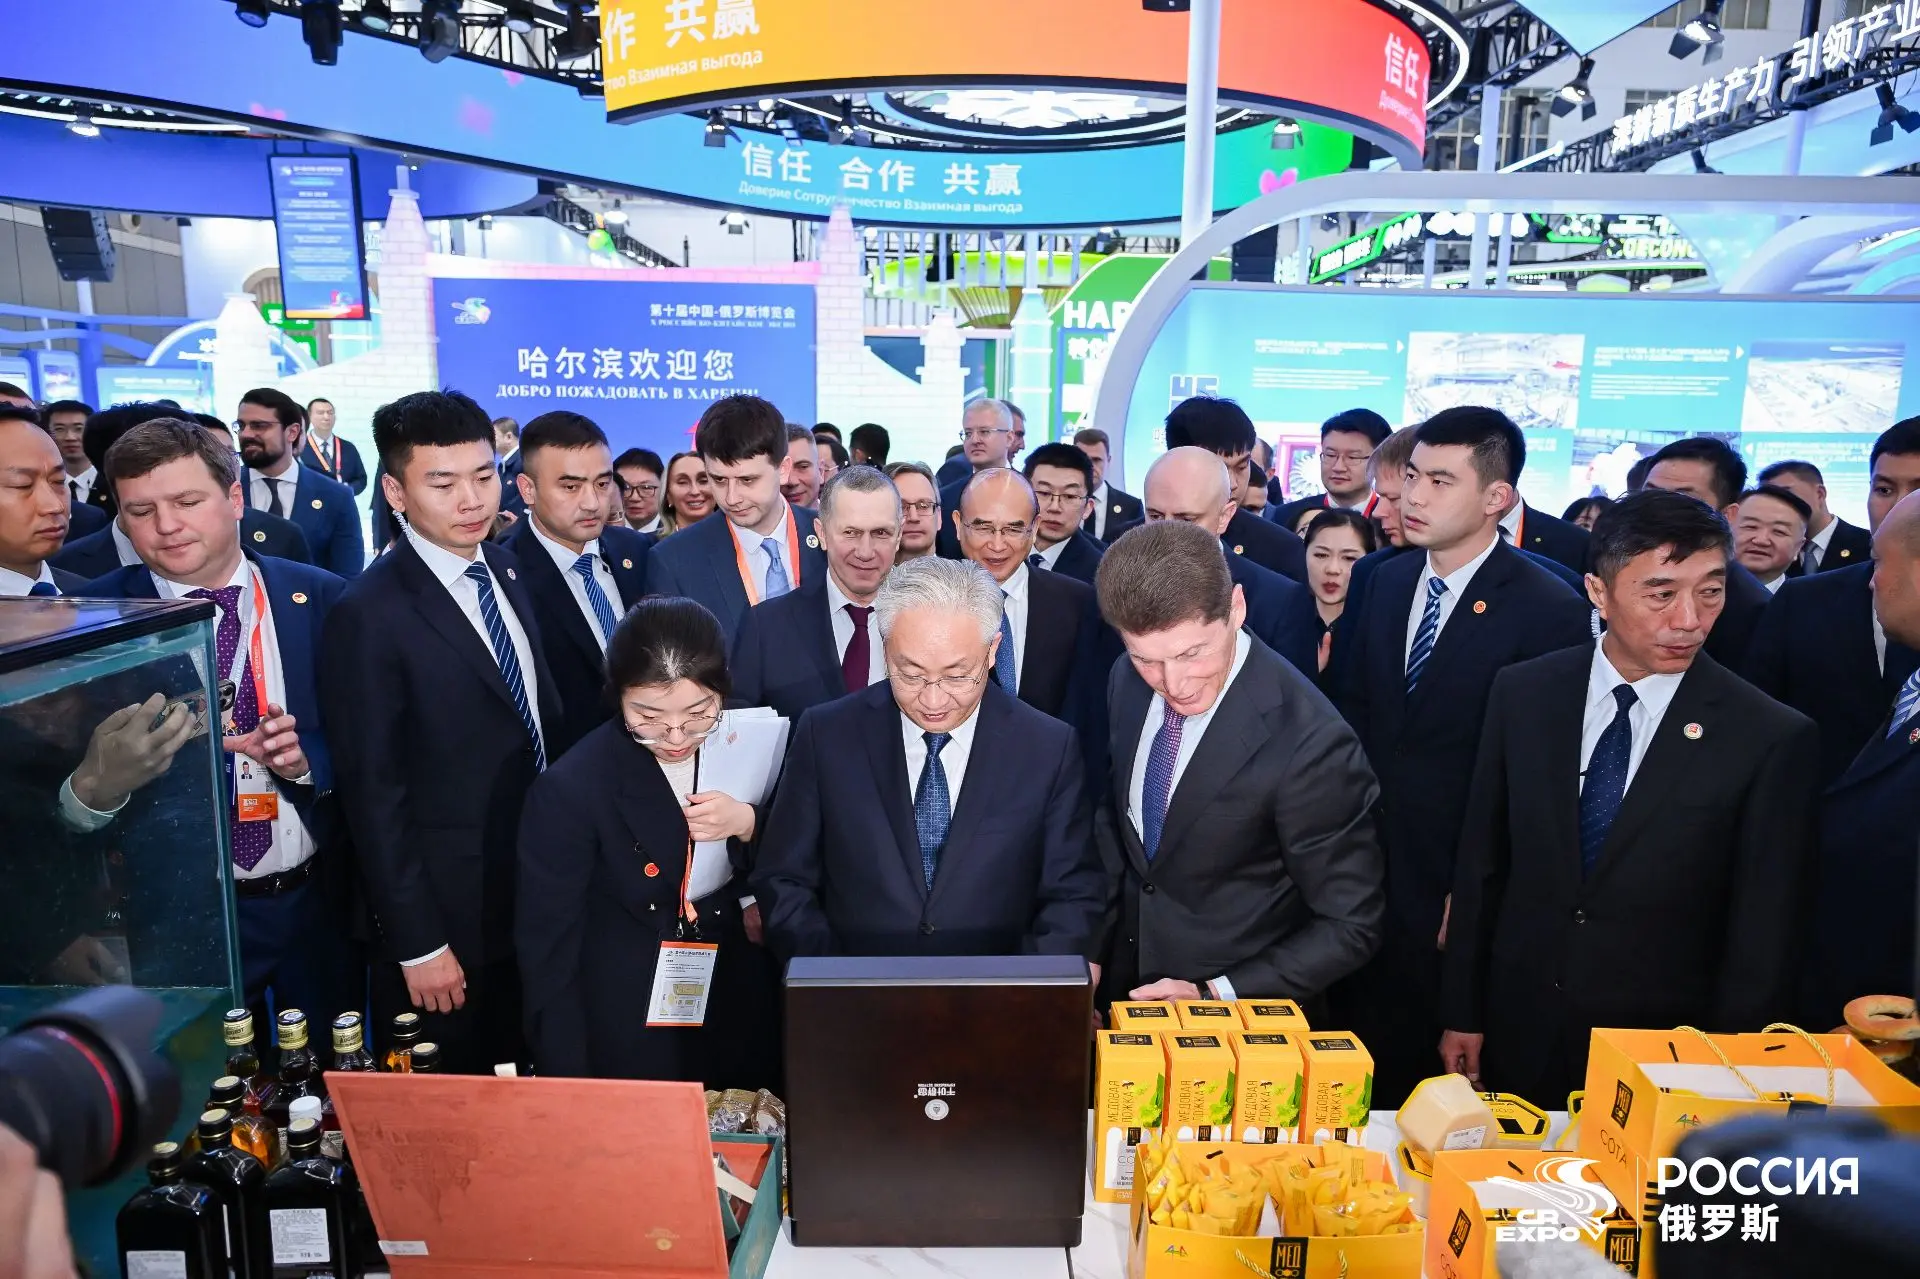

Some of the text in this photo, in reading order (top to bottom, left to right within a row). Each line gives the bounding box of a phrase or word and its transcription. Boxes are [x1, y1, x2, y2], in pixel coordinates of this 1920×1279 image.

[604, 0, 760, 63] 作 共赢
[628, 60, 698, 85] Взаимная
[701, 50, 763, 71] выгода
[1384, 32, 1420, 99] 信任
[741, 140, 1023, 197] 信任 合作 共赢
[738, 180, 792, 201] Доверие
[903, 198, 971, 212] Взаимная
[973, 202, 1023, 214] выгода
[517, 346, 735, 381] 哈尔滨欢迎您
[496, 383, 551, 398] ДОБРО
[673, 387, 684, 400] В
[1275, 1243, 1301, 1269] МЕД
[1609, 1237, 1635, 1262] МЕД
